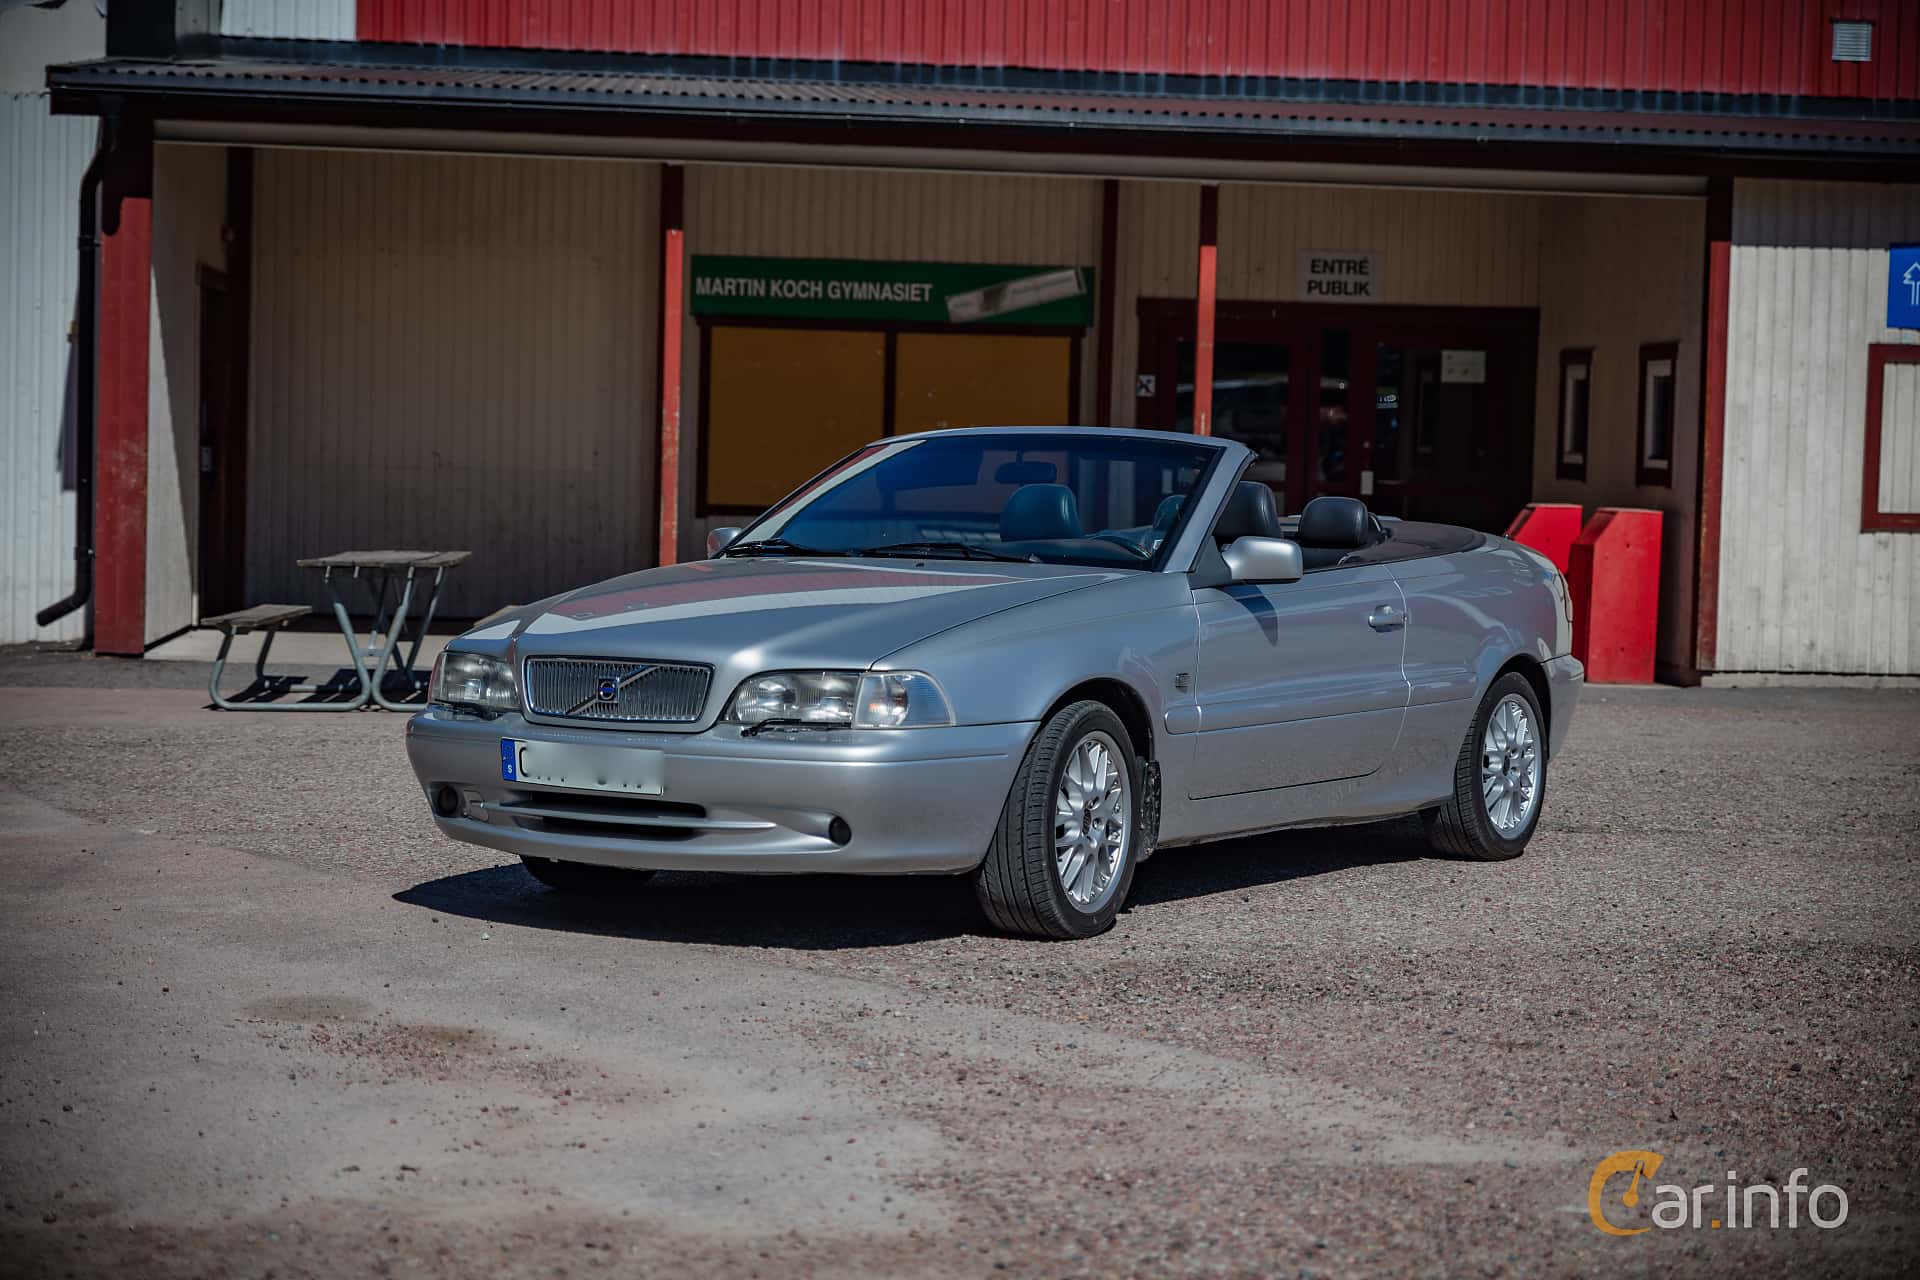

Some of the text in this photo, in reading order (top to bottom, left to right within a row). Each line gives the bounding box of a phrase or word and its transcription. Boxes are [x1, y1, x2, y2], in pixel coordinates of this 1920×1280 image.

[1310, 256, 1369, 275] ENTRÉ
[695, 277, 933, 302] MARTIN KOCH GYMNASIET
[1307, 280, 1370, 296] PUBLIK
[507, 764, 513, 774] S
